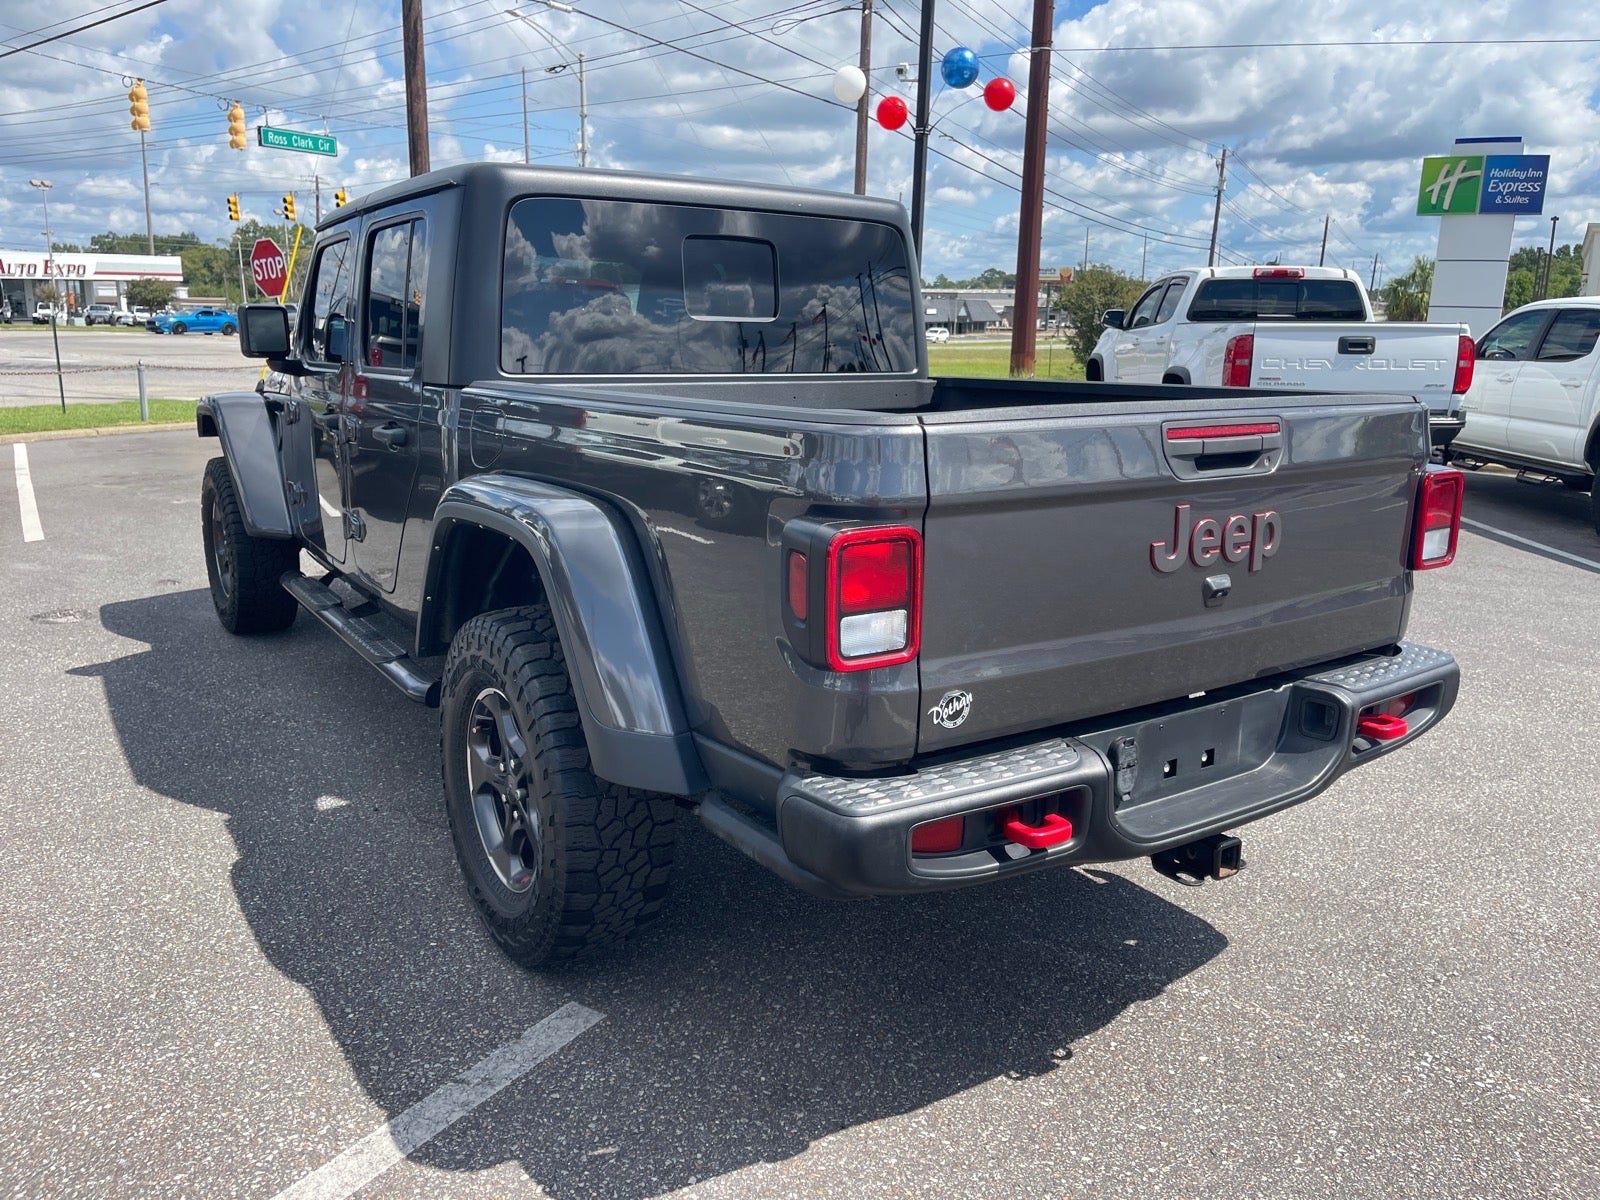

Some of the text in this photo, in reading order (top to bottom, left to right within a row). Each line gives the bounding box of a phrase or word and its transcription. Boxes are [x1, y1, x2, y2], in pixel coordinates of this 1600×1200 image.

[267, 131, 330, 151] Ross Clark Cir
[1490, 167, 1543, 179] Holiday Inn
[1488, 179, 1541, 195] Express
[1495, 195, 1529, 203] & Suites
[253, 256, 283, 281] STOP
[1150, 502, 1282, 573] Jeep
[927, 692, 973, 725] Dothan
